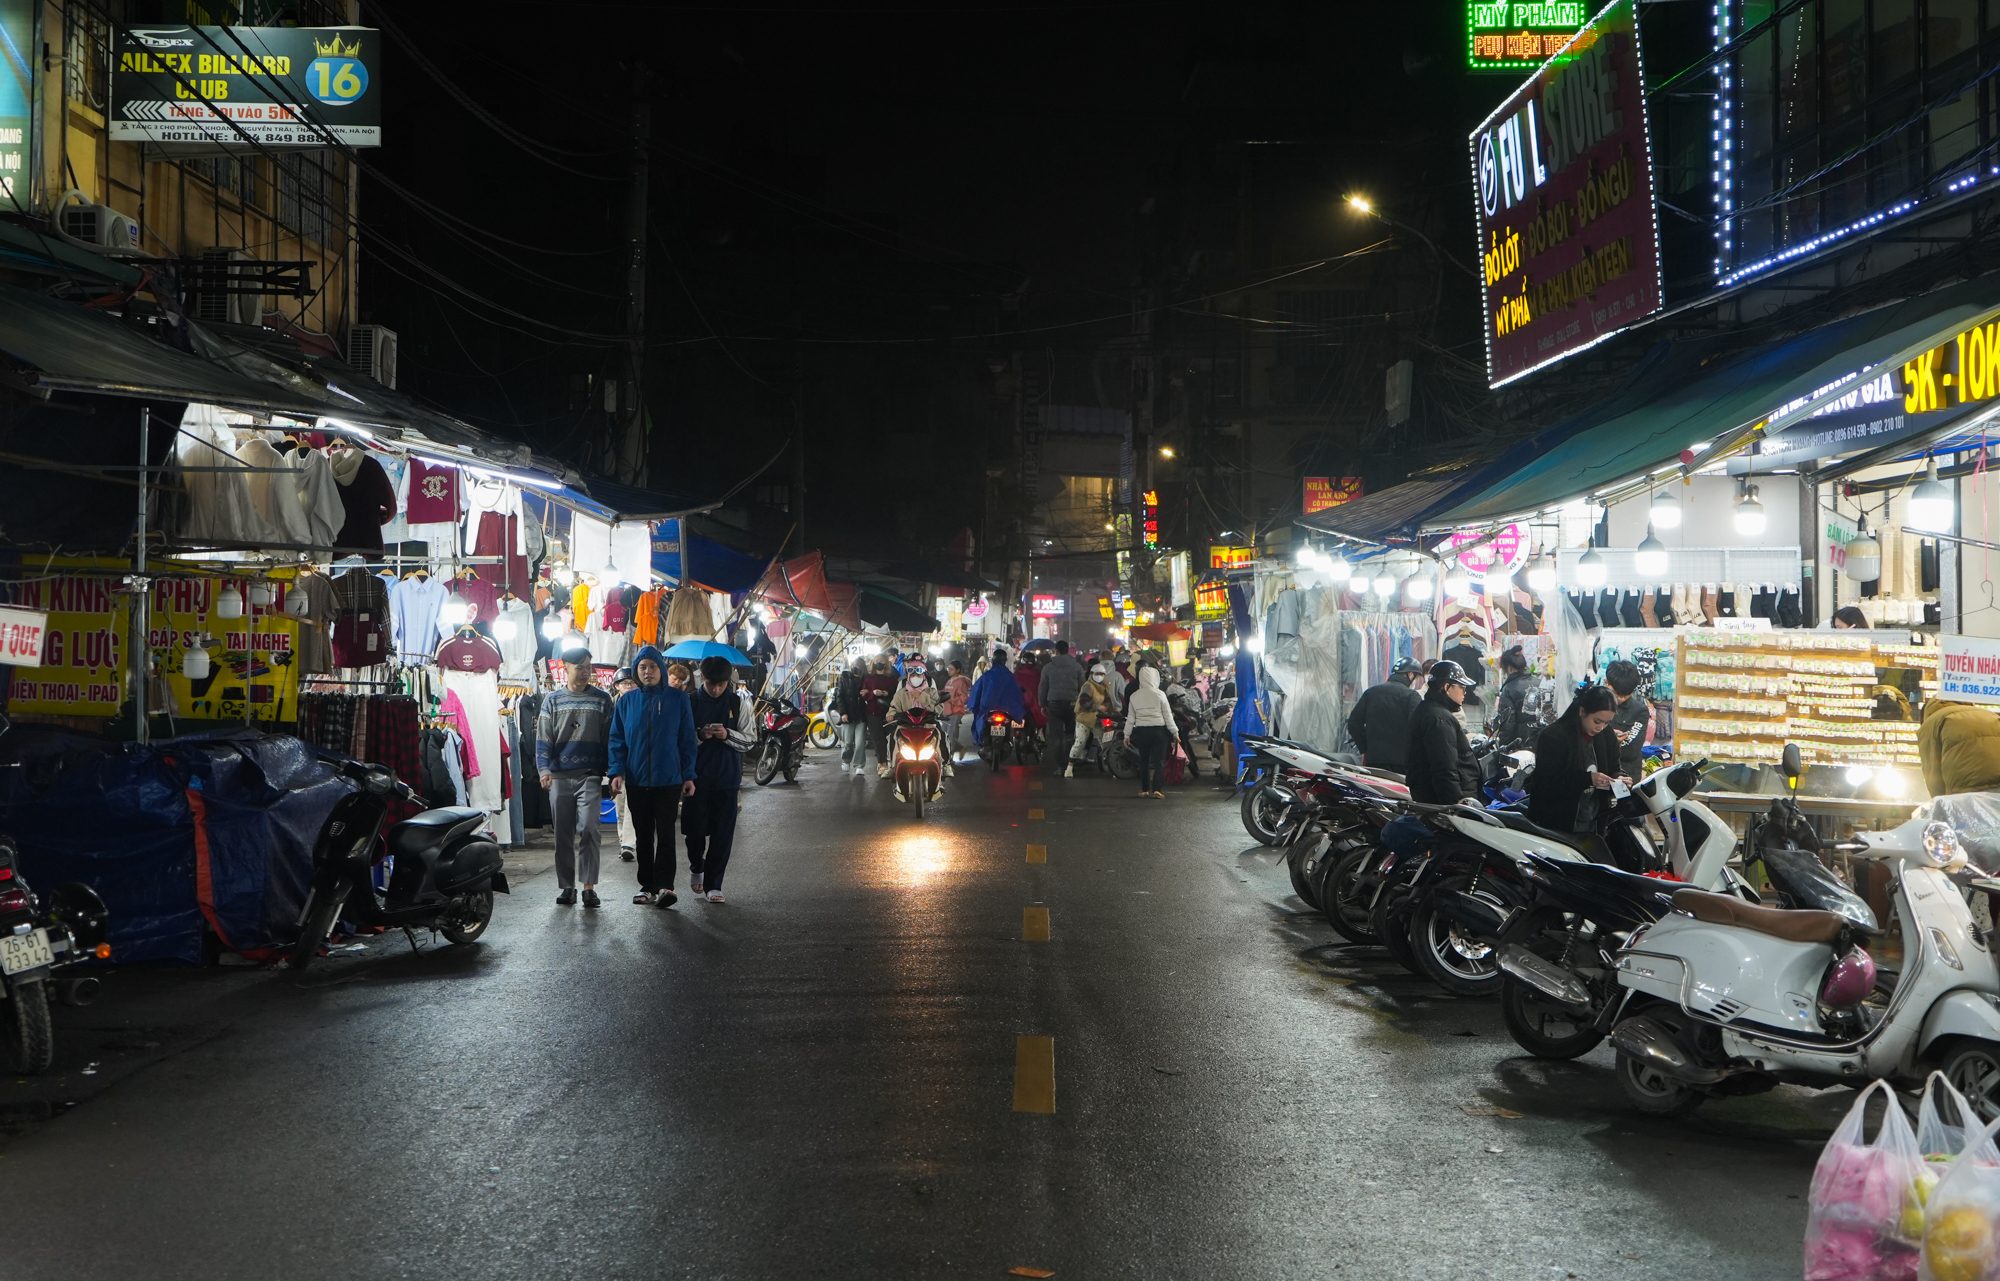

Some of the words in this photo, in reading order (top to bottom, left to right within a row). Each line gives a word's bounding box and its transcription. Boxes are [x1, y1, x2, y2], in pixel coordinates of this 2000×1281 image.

[1474, 35, 1503, 60] PHỤ
[1506, 30, 1541, 59] KIỆN
[1543, 34, 1576, 55] TEE
[198, 54, 291, 76] BILLIARD
[176, 79, 228, 100] CLUB
[314, 62, 361, 98] 16
[208, 107, 217, 118] 3
[237, 106, 262, 119] VÀO
[268, 106, 295, 120] 5M
[1498, 99, 1546, 209] FULL
[1543, 36, 1615, 173] STORE
[162, 132, 228, 142] HOTLINE:
[265, 134, 292, 142] 849
[5, 151, 21, 172] NỘI
[1501, 226, 1519, 277] LÓT
[1496, 295, 1510, 338] MỸ
[1597, 236, 1628, 284] TEEN
[1905, 349, 1937, 413] 5K
[155, 578, 211, 622] PHỤ
[9, 623, 40, 658] QUE
[72, 628, 119, 675] LỰC
[150, 627, 178, 648] CÁP
[226, 632, 247, 650] TAI
[251, 633, 290, 651] NGHE
[1945, 649, 1974, 674] TUYỂN
[41, 683, 79, 705] THOẠI
[88, 684, 119, 702] IPAD
[1944, 682, 1959, 693] LH:
[6, 946, 51, 973] 233.42
